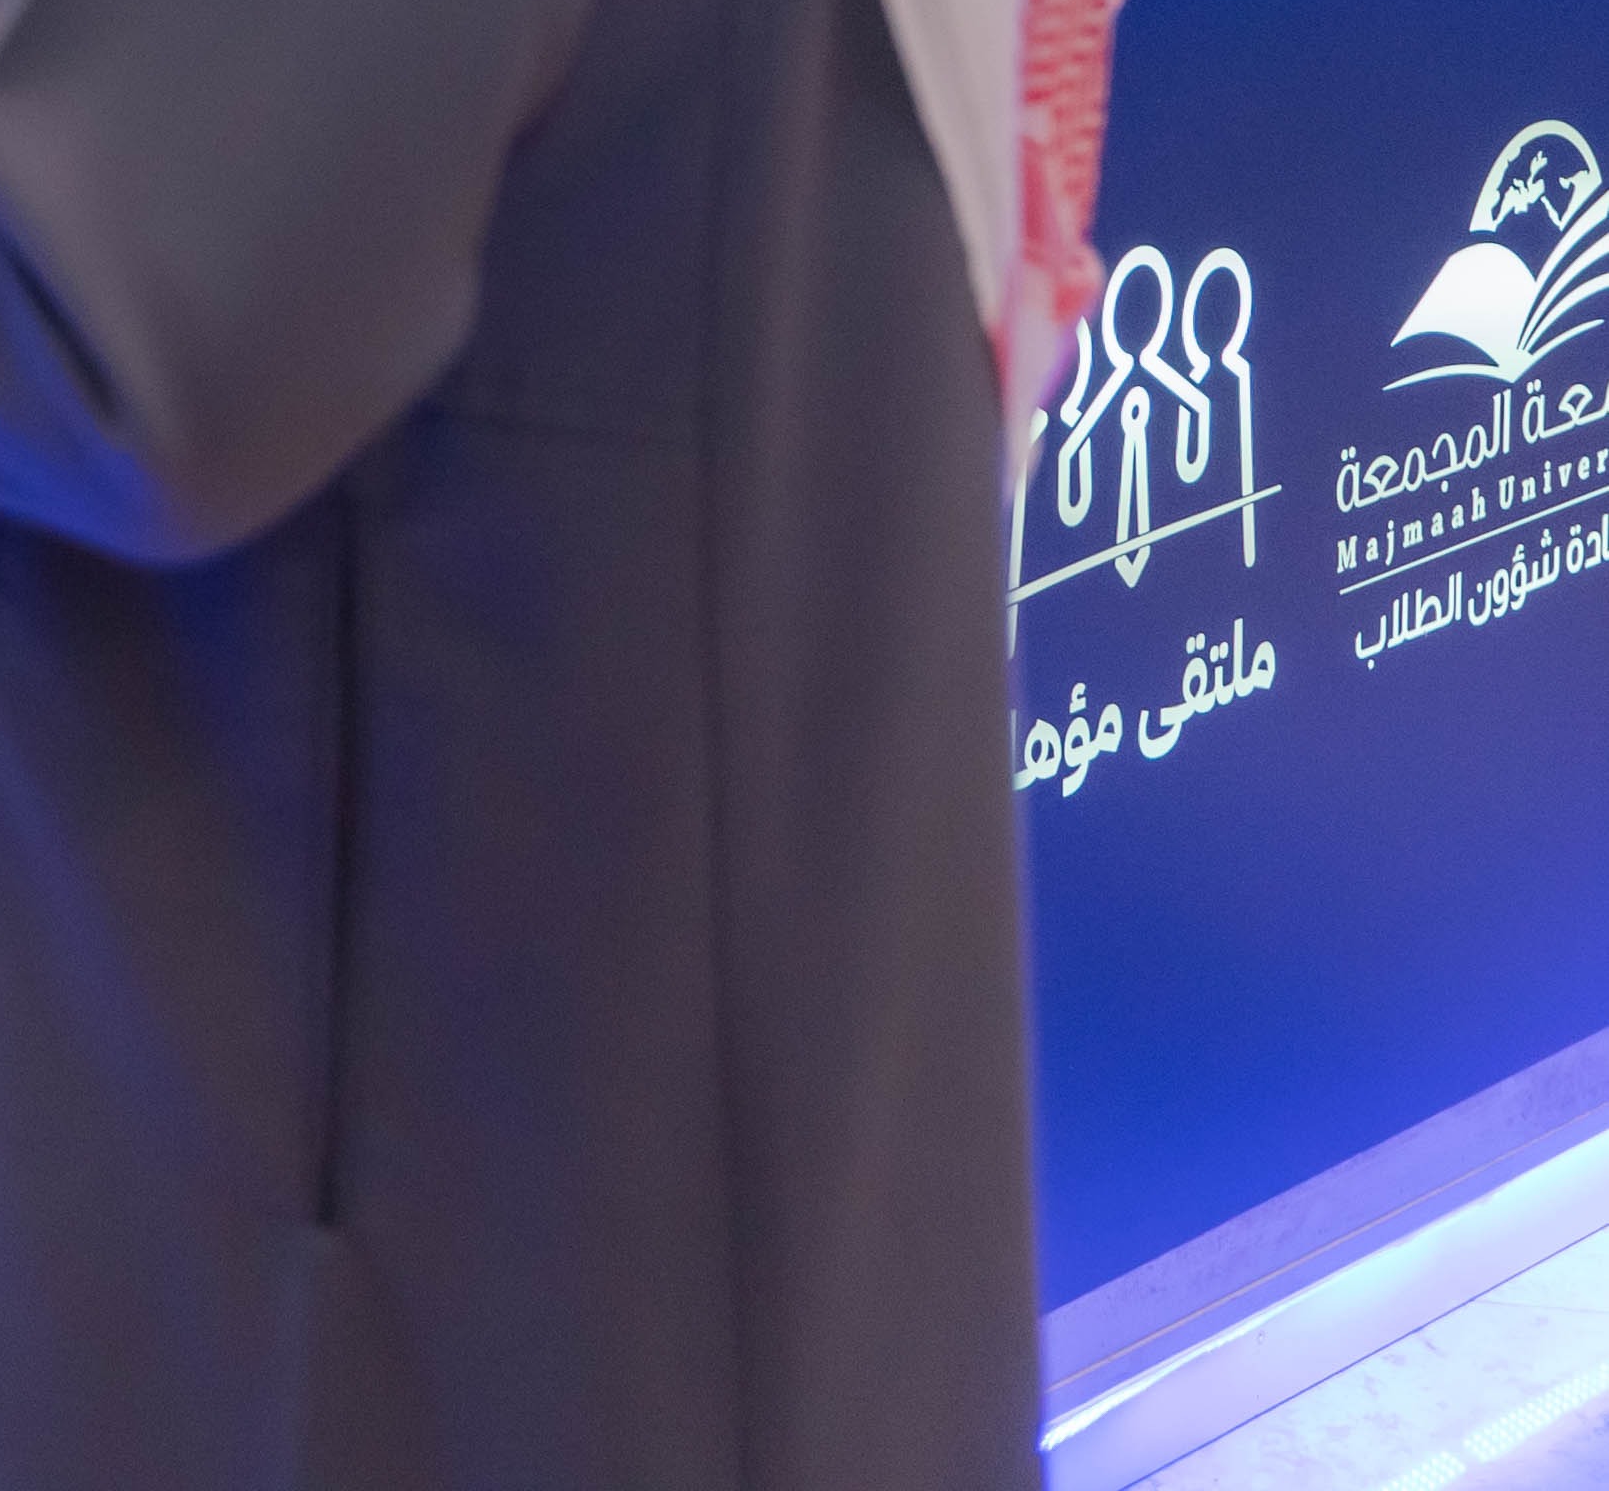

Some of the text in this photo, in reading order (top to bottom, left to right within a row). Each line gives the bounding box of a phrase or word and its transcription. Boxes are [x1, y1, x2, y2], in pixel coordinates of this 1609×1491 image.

[1336, 388, 1513, 513] المجمعة
[1336, 447, 1609, 575] Majmaah Univer
[1354, 513, 1609, 671] ادة شؤون الطلاب
[1013, 617, 1277, 799] ملتقى مؤه
